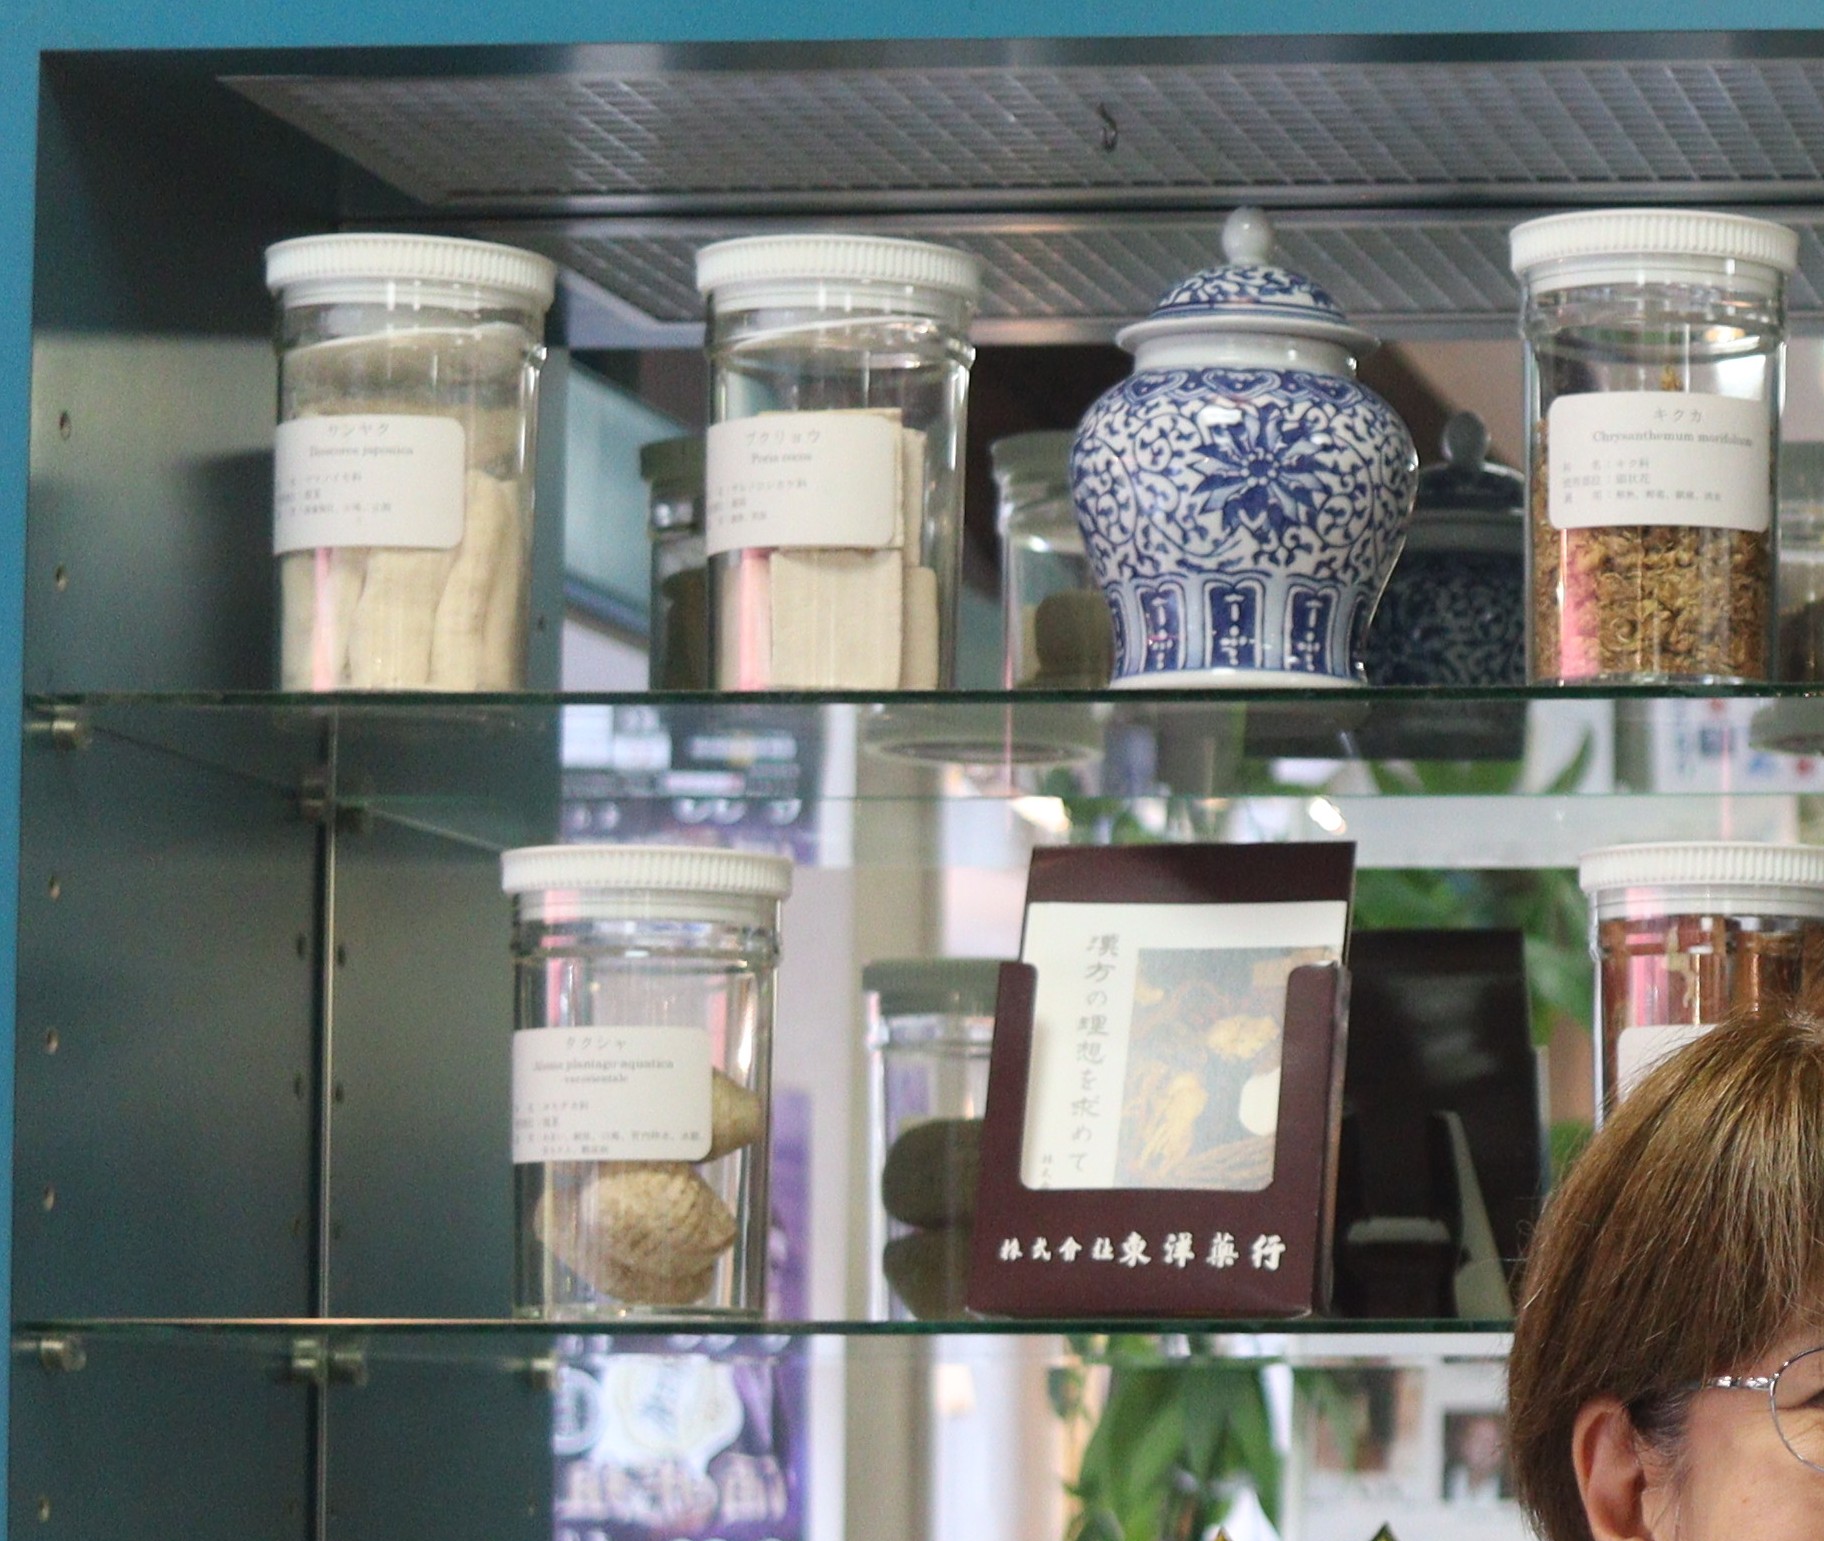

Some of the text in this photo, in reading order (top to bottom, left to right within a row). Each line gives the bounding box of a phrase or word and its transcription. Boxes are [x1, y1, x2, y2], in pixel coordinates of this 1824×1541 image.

[1069, 932, 1121, 1172] 漢方の理想を求めて
